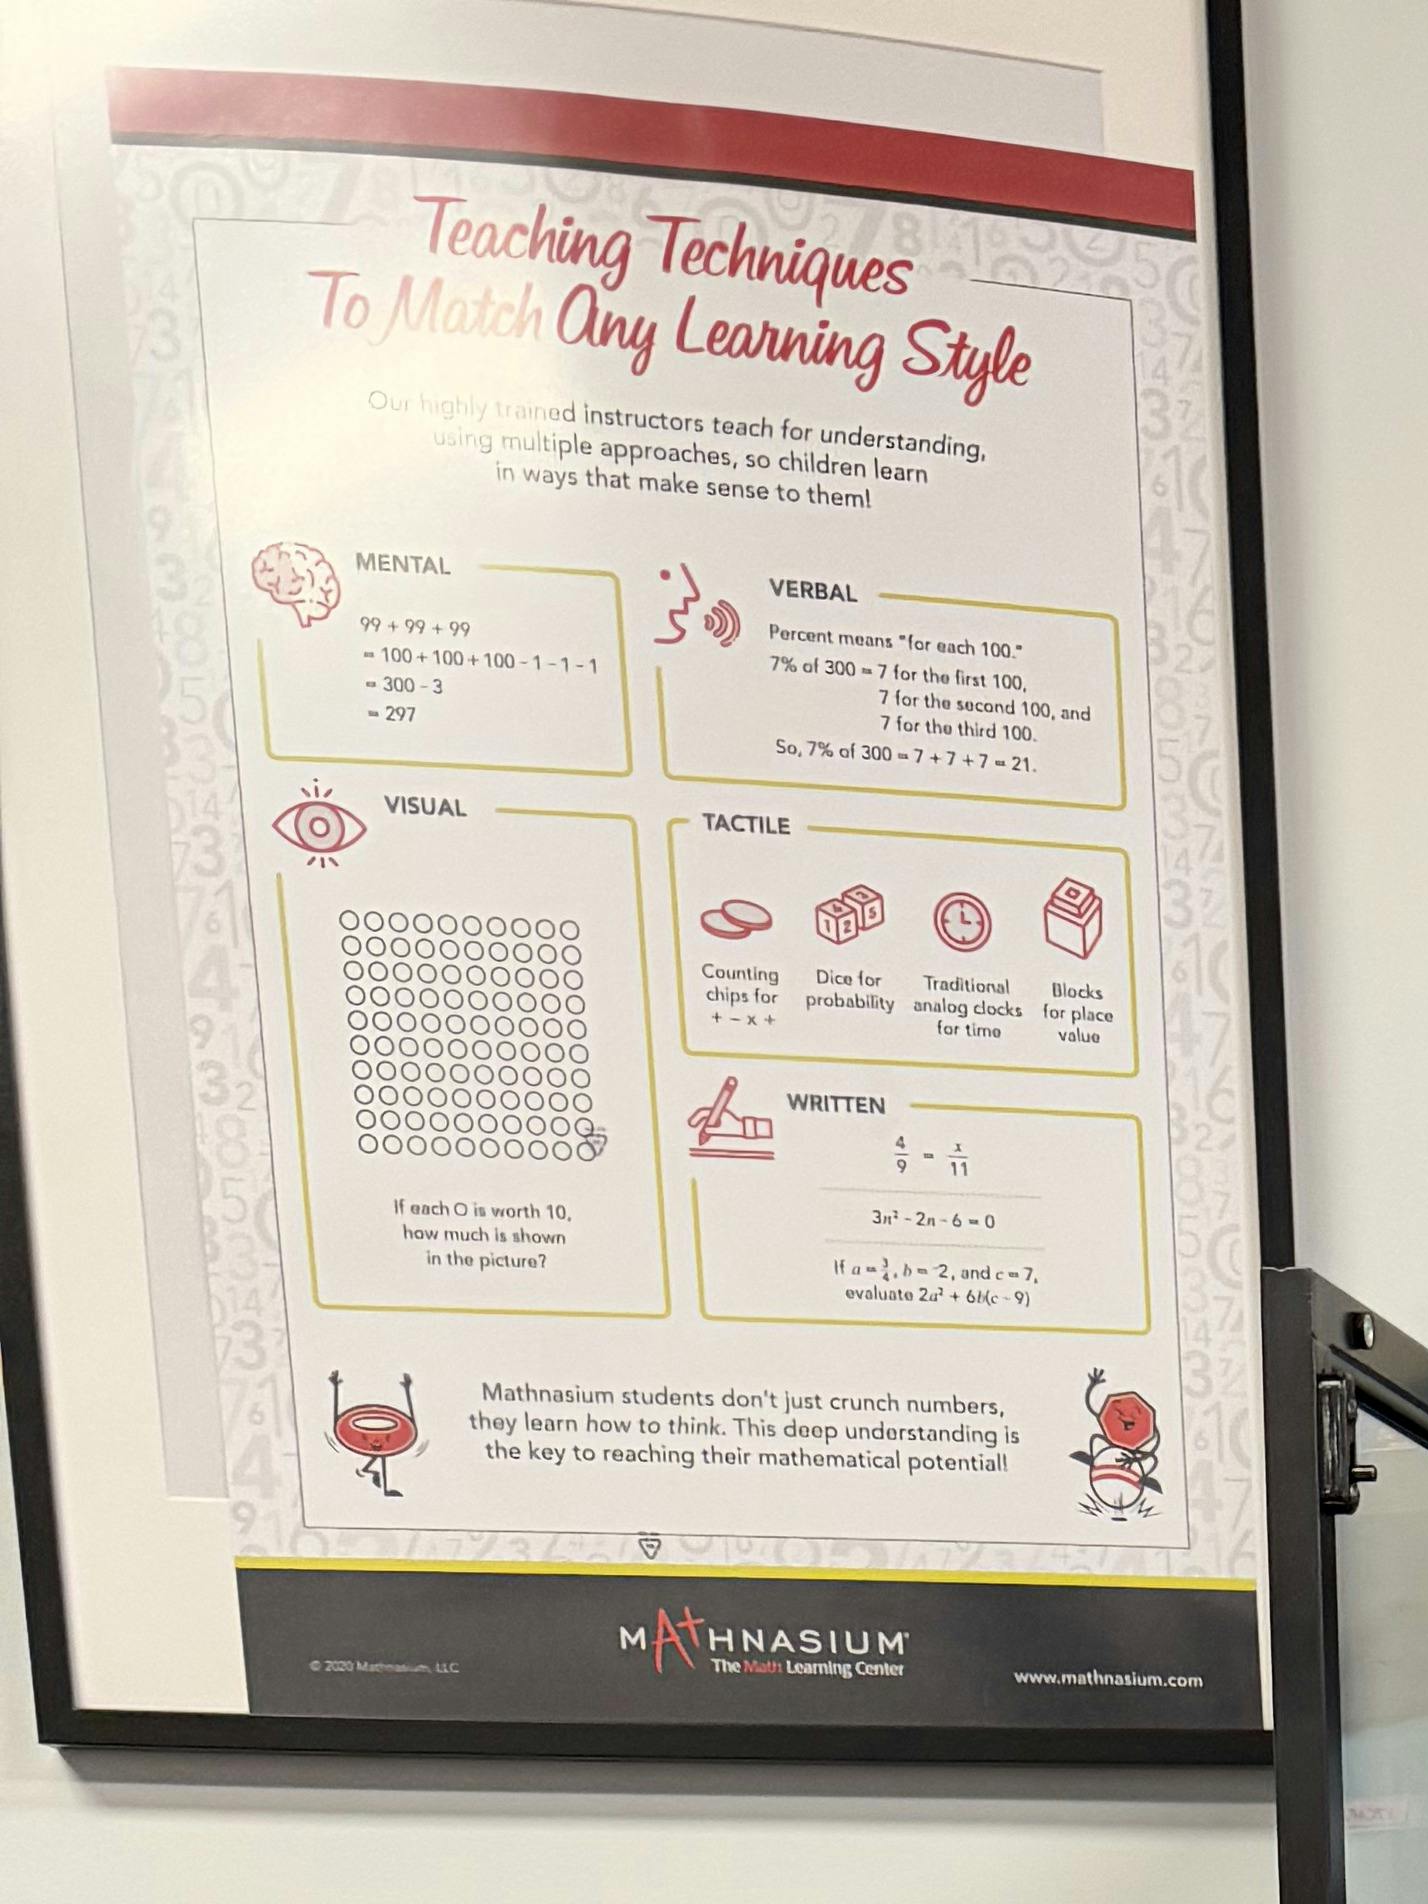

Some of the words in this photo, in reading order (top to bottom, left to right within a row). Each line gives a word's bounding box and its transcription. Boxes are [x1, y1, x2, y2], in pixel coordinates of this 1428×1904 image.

[412, 195, 634, 290] Teaching
[645, 214, 915, 308] Techniques
[307, 269, 370, 331] To
[372, 275, 542, 347] Match
[555, 282, 660, 377] Any
[675, 295, 887, 394] Learning
[900, 318, 1034, 408] Style
[367, 389, 414, 414] Our
[418, 392, 487, 422] highly
[494, 396, 578, 427] trained
[583, 402, 705, 433] instructors
[711, 415, 774, 440] teach
[779, 419, 814, 443] for
[819, 425, 986, 463] understanding,
[433, 428, 494, 455] using
[500, 431, 593, 461] multiple
[599, 441, 738, 471] approaches,
[744, 452, 771, 470] so
[777, 449, 867, 479] children
[873, 455, 929, 485] learn
[494, 459, 516, 483] in
[521, 466, 579, 490] ways
[584, 464, 632, 491] that
[637, 470, 700, 495] make
[705, 480, 770, 501] sense
[774, 482, 801, 504] to
[805, 481, 872, 510] them!
[355, 551, 452, 576] MENTAL
[768, 577, 859, 604] VERBAL
[768, 622, 834, 645] Percent
[837, 632, 894, 649] means
[897, 632, 932, 652] "for
[935, 637, 976, 657] each
[980, 640, 1023, 660] 100."
[383, 794, 468, 818] VISUAL
[701, 812, 791, 836] TACTILE
[700, 962, 780, 987] Counting
[815, 967, 853, 987] Dice
[856, 968, 883, 988] for
[922, 973, 1011, 997] Traditional
[704, 984, 750, 1009] chips
[752, 986, 780, 1005] for
[804, 991, 896, 1015] probability
[1050, 981, 1105, 1002] Blocks
[912, 996, 969, 1019] analog
[972, 999, 1024, 1019] clocks
[1042, 1001, 1067, 1021] for
[1070, 1004, 1114, 1026] place
[936, 1018, 961, 1037] for
[964, 1021, 1002, 1040] time
[1056, 1028, 1102, 1045] value
[786, 1092, 887, 1116] WRITTEN
[392, 1196, 406, 1216] If
[409, 1199, 451, 1217] each
[452, 1200, 469, 1217] O
[472, 1200, 487, 1218] is
[490, 1201, 541, 1220] worth
[545, 1203, 573, 1223] 10,
[401, 1222, 439, 1241] how
[443, 1225, 490, 1243] much
[493, 1226, 508, 1244] is
[511, 1225, 567, 1246] shown
[424, 1248, 443, 1267] in
[445, 1248, 475, 1268] the
[478, 1251, 548, 1273] picture?
[480, 1381, 615, 1405] Mathnasium
[621, 1384, 715, 1407] students
[720, 1386, 779, 1410] don't
[783, 1389, 823, 1416] just
[828, 1391, 900, 1413] crunch
[905, 1393, 1005, 1419] numbers,
[467, 1408, 518, 1437] they
[523, 1410, 579, 1433] learn
[585, 1411, 632, 1434] how
[637, 1416, 662, 1435] to
[667, 1414, 727, 1437] think.
[731, 1415, 777, 1438] This
[782, 1416, 839, 1446] deep
[844, 1419, 998, 1449] understanding
[1003, 1424, 1021, 1445] is
[483, 1438, 522, 1461] the
[527, 1439, 567, 1467] key
[571, 1444, 596, 1463] to
[602, 1441, 695, 1470] reaching
[700, 1443, 752, 1466] their
[757, 1446, 901, 1470] mathematical
[907, 1451, 1009, 1477] potential!
[708, 1656, 742, 1675] The
[742, 1658, 783, 1674] Math
[784, 1658, 854, 1680] Learning
[853, 1659, 905, 1677] Center
[1013, 1668, 1204, 1689] www.mathnasium.com
